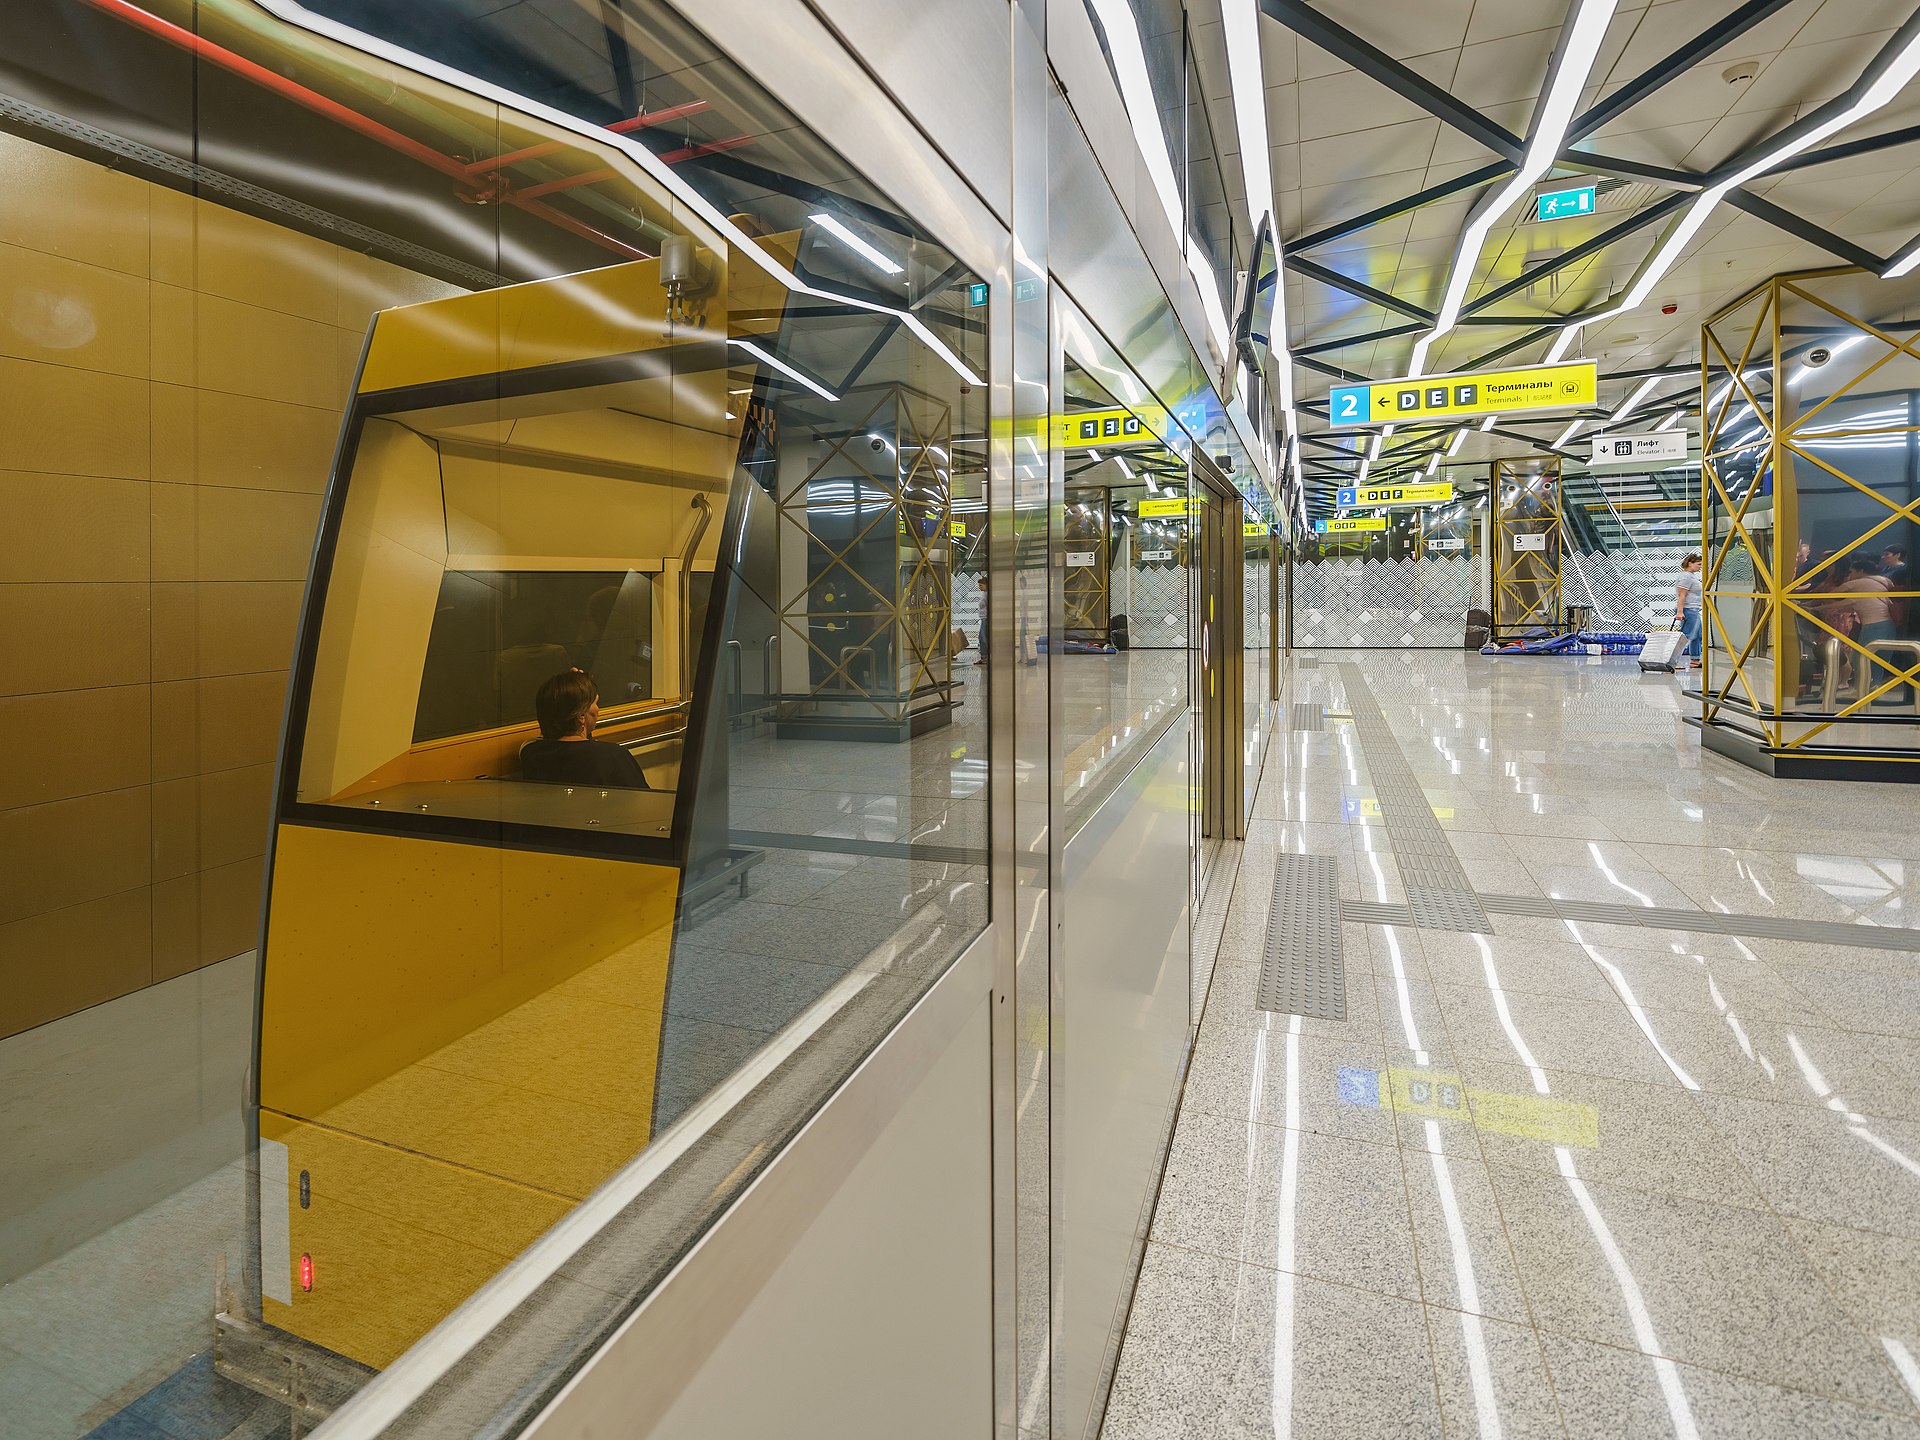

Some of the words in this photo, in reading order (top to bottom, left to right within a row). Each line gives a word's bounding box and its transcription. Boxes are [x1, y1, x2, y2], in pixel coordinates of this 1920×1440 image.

[1486, 380, 1553, 394] Терминалы
[1340, 394, 1358, 417] 2
[1401, 393, 1416, 409] D
[1431, 390, 1443, 406] E
[1460, 387, 1471, 403] F
[1486, 395, 1523, 405] Terminals
[1636, 439, 1660, 448] Лифт
[1342, 491, 1352, 503] 2
[1369, 492, 1377, 500] D
[1382, 491, 1390, 499] E
[1394, 490, 1402, 499] F
[1318, 523, 1325, 531] 2
[1516, 536, 1522, 544] S
